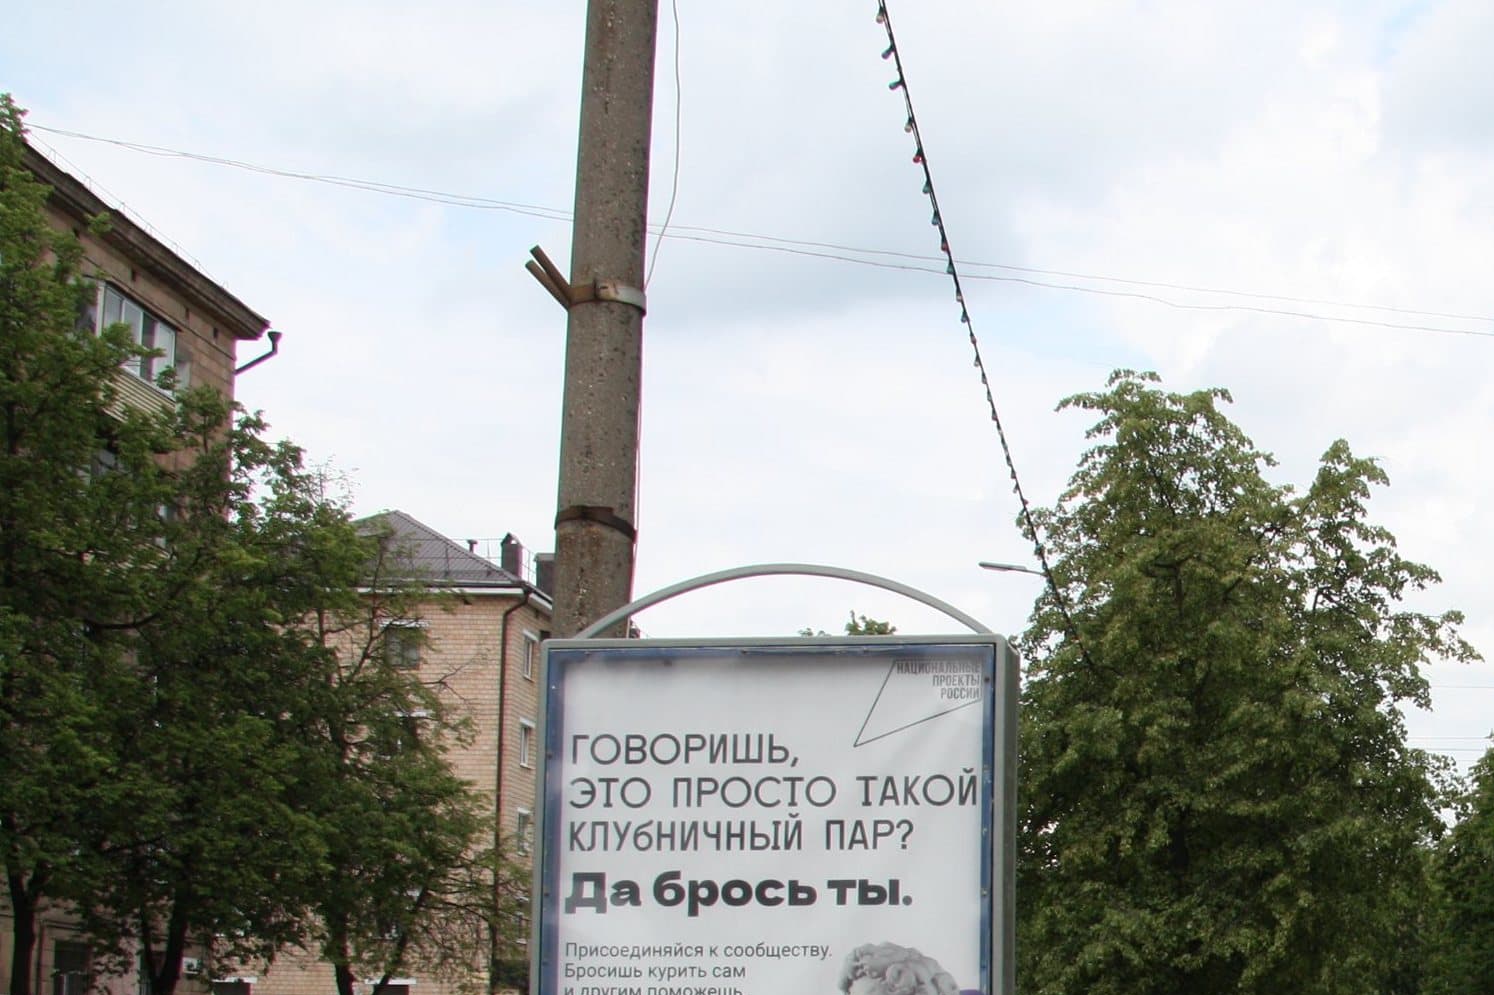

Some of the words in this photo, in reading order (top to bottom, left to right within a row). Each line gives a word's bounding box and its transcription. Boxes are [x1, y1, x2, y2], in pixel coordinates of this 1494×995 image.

[897, 662, 980, 674] НАЦИОНАЛЬНЫЕ
[932, 674, 980, 686] ПРОЕКТЫ
[941, 687, 980, 699] РОССИИ
[572, 734, 799, 767] ГОВОРИШЬ,
[569, 777, 651, 808] ЭТО
[673, 777, 836, 808] ПРОСТО
[856, 769, 977, 807] ТАКОЙ
[825, 820, 914, 851] ПАР?
[565, 872, 642, 914] Да
[653, 870, 817, 917] брось
[827, 880, 913, 906] ты.
[565, 942, 704, 959] Присоединяйся
[709, 946, 719, 957] к
[724, 942, 833, 960] сообществу.
[564, 963, 643, 980] Бросишь
[648, 966, 708, 981] курить
[712, 966, 746, 978] сам
